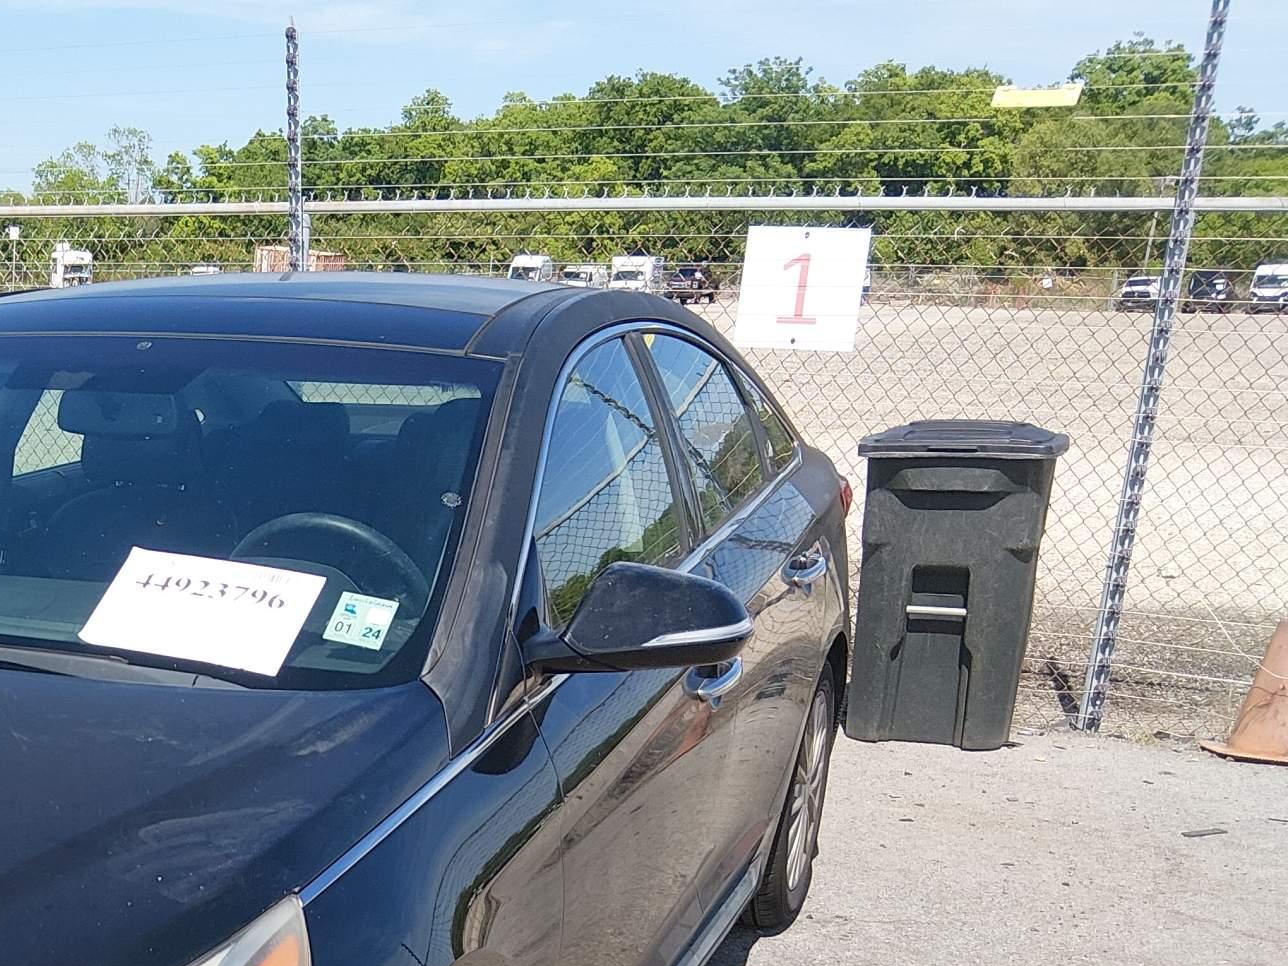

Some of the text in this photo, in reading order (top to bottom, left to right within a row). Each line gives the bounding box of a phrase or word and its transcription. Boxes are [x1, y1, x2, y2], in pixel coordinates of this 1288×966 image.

[776, 253, 817, 325] 1
[135, 573, 285, 609] 44923796
[334, 621, 382, 640] 01 24
